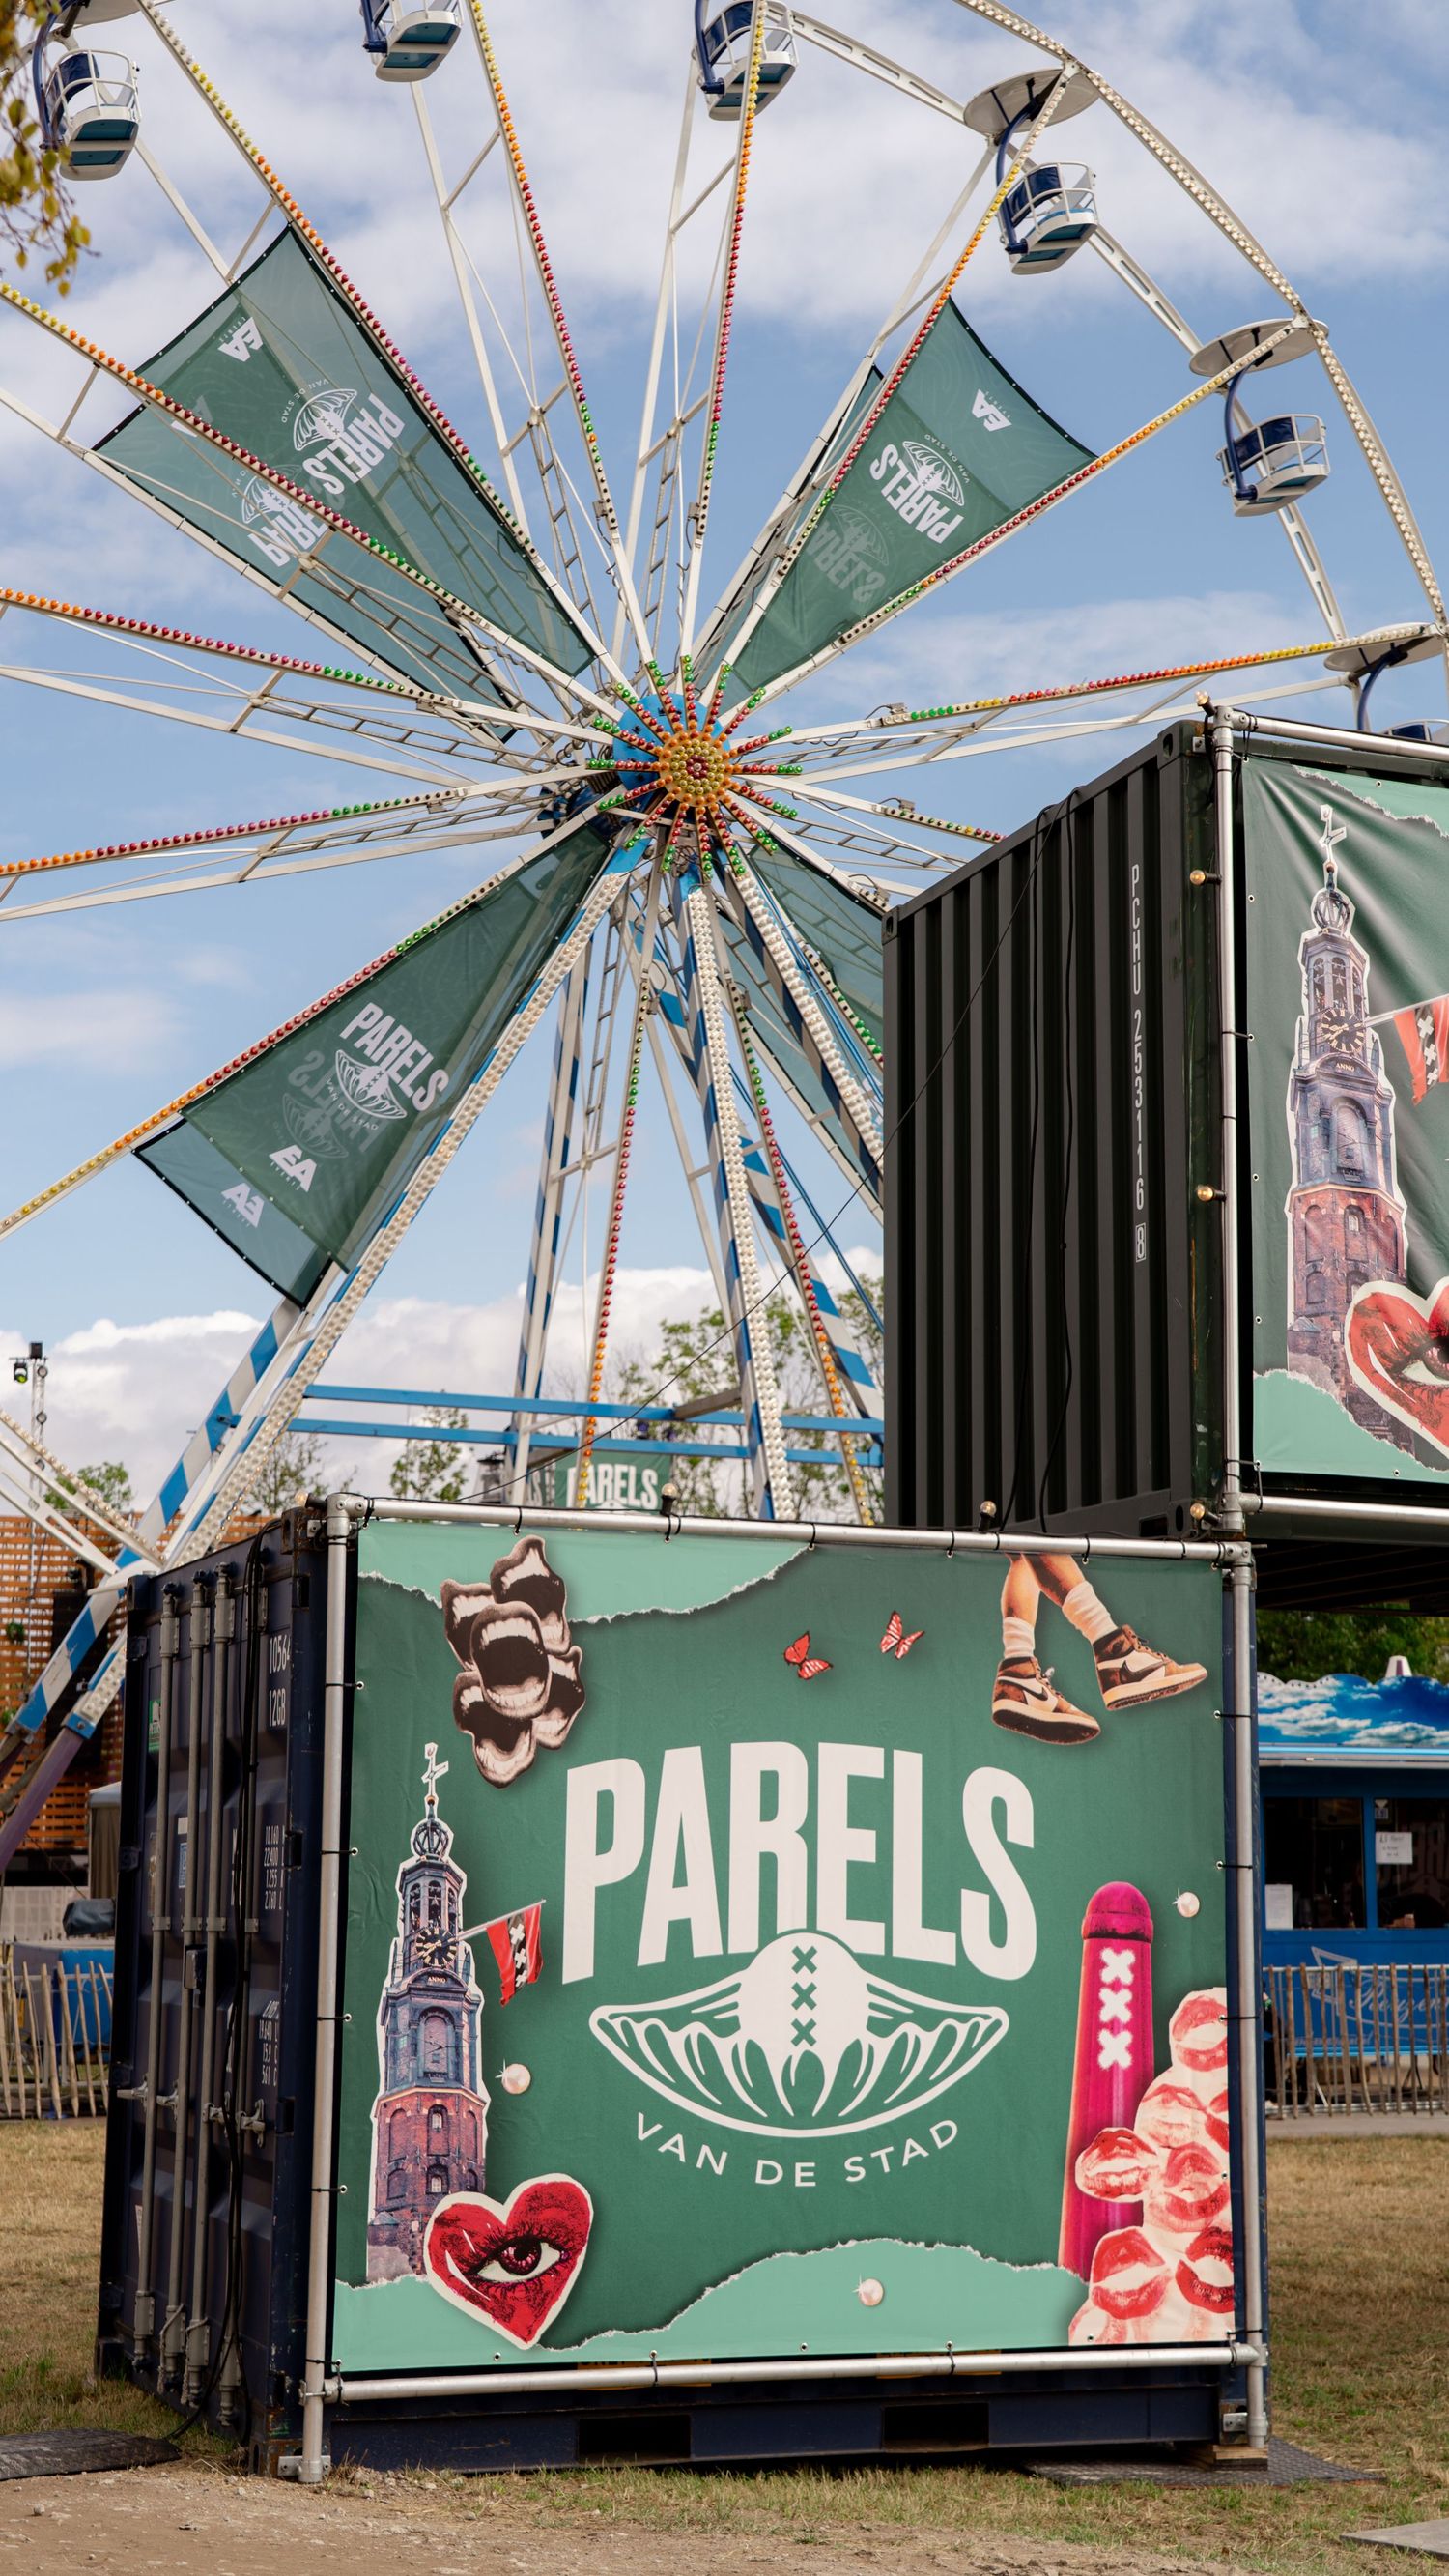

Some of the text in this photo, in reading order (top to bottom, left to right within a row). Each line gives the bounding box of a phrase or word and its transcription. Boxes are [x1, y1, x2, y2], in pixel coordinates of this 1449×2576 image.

[217, 317, 263, 362] EA
[281, 378, 329, 423] VAN DE STAD
[972, 388, 1012, 432] EA
[302, 393, 406, 495] PARELS
[924, 434, 971, 484] VAN DE STAD
[869, 444, 964, 544] PARELS
[339, 1002, 450, 1112] PARELS
[1131, 864, 1145, 1260] PCHU 253116 8
[1335, 1062, 1356, 1073] ANNO
[326, 1079, 338, 1102] VAN
[351, 1116, 380, 1131] STAD
[269, 1144, 318, 1193] EA
[562, 1741, 1037, 1986] PARELS
[427, 1975, 447, 1984] ANNO
[638, 2110, 959, 2188] VAN DE STAD
